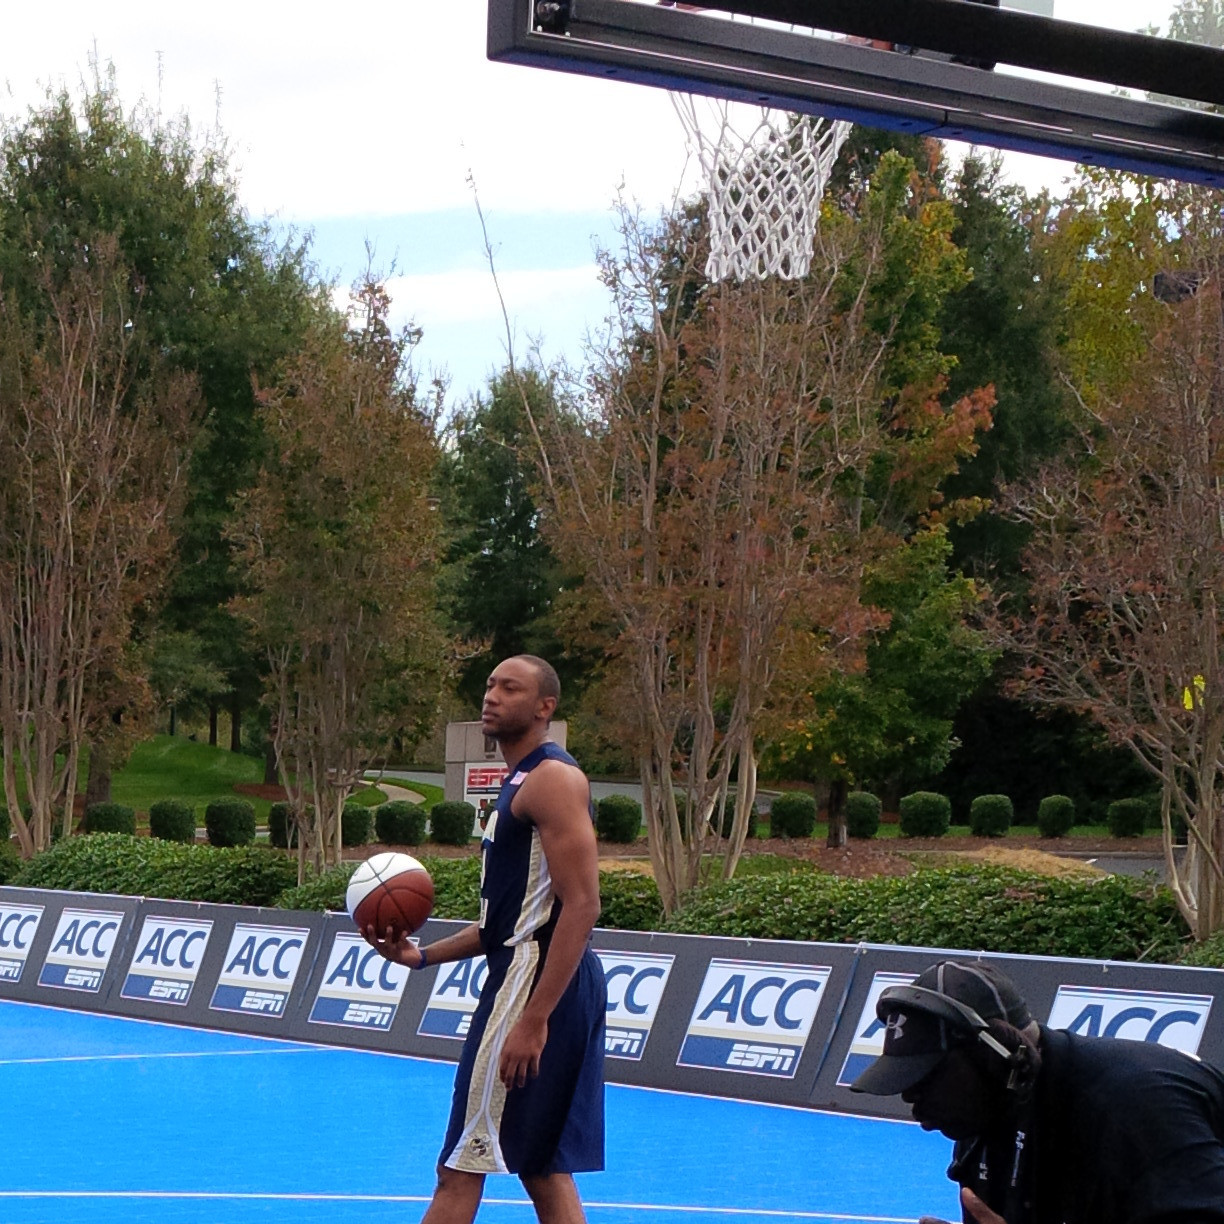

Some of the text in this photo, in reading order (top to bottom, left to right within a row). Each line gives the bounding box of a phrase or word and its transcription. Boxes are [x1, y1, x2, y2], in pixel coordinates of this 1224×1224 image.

[51, 919, 118, 958] ACC
[135, 927, 206, 969] ACC
[225, 935, 303, 980] ACC
[64, 968, 101, 988] ESPN
[148, 979, 190, 1000] ESPN
[436, 957, 489, 999] AC
[604, 964, 666, 1015] CC
[240, 990, 285, 1012] ESPN
[342, 1003, 392, 1026] ESPN
[696, 974, 821, 1030] ACC
[726, 1043, 795, 1072] ESPN
